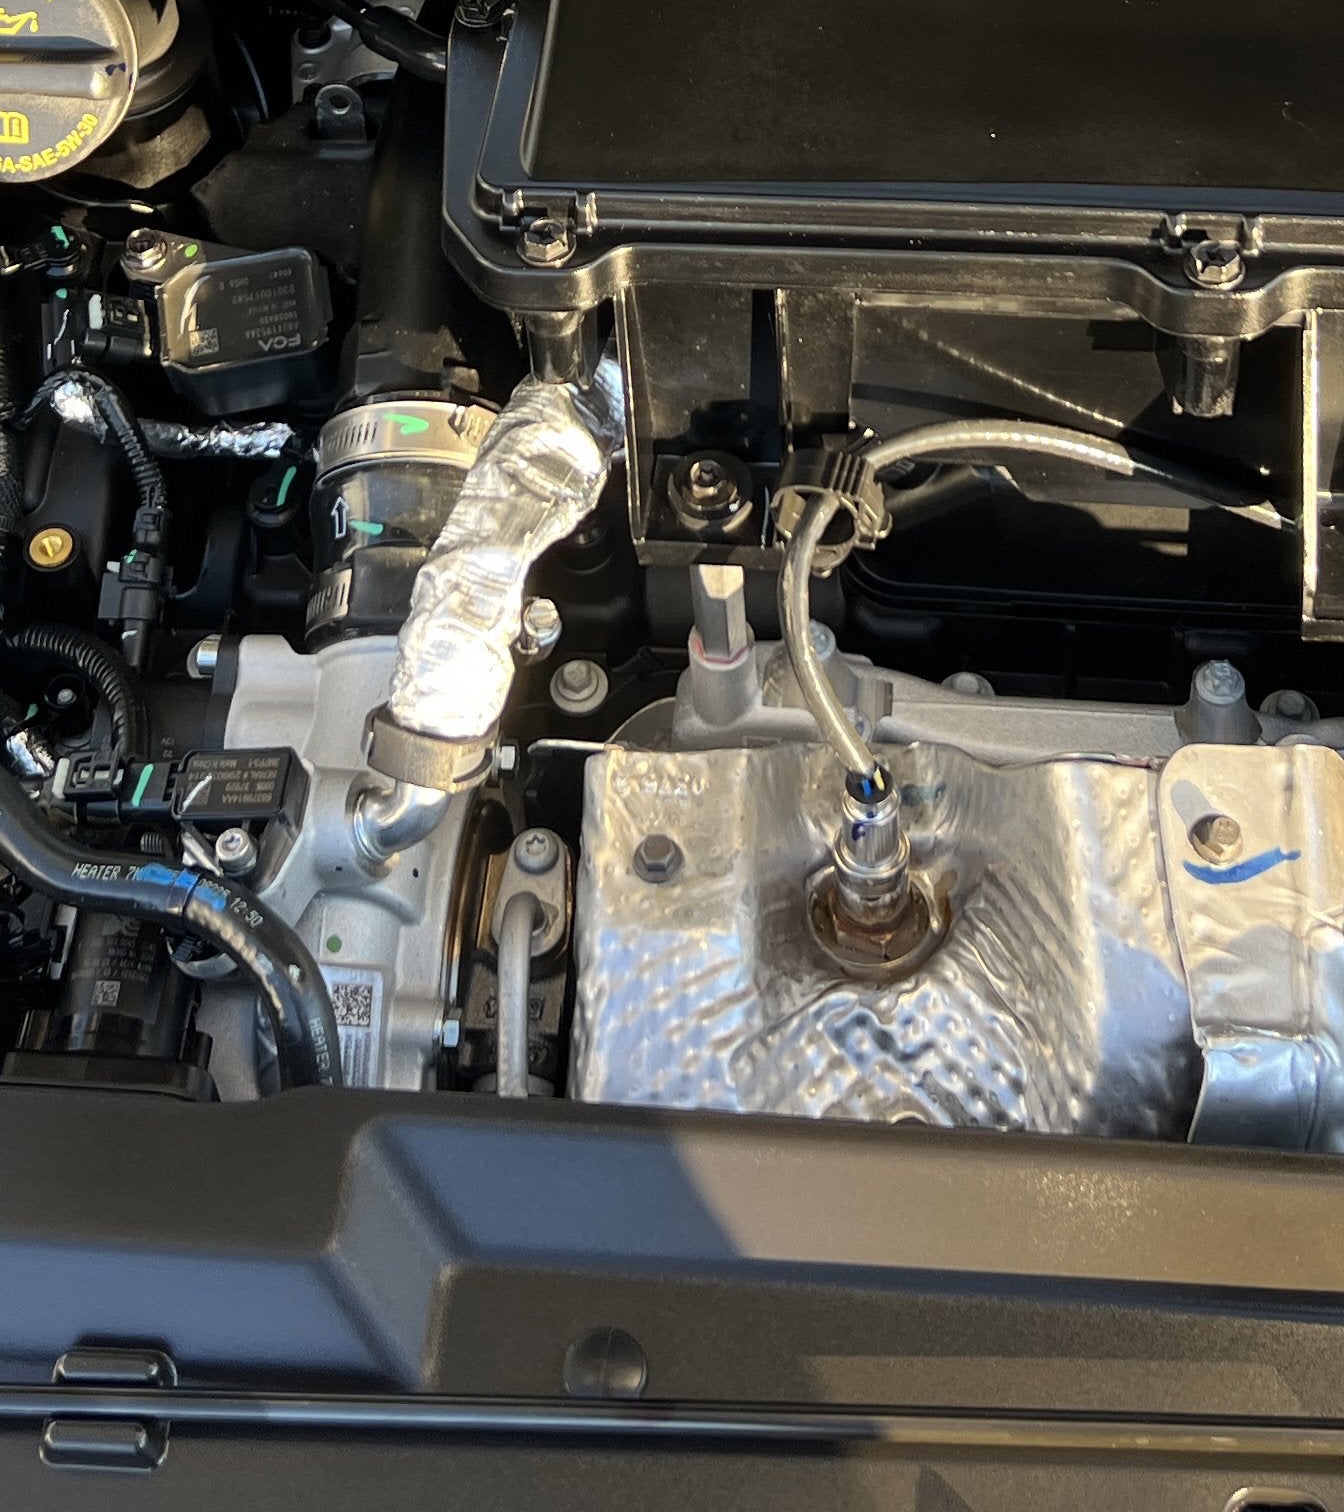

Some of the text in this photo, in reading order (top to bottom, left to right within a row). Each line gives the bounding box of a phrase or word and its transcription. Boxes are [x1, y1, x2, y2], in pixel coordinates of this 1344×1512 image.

[257, 333, 301, 352] FCA
[71, 862, 121, 879] HEATER
[229, 896, 264, 928] 12:50
[307, 1016, 331, 1071] HEATER
